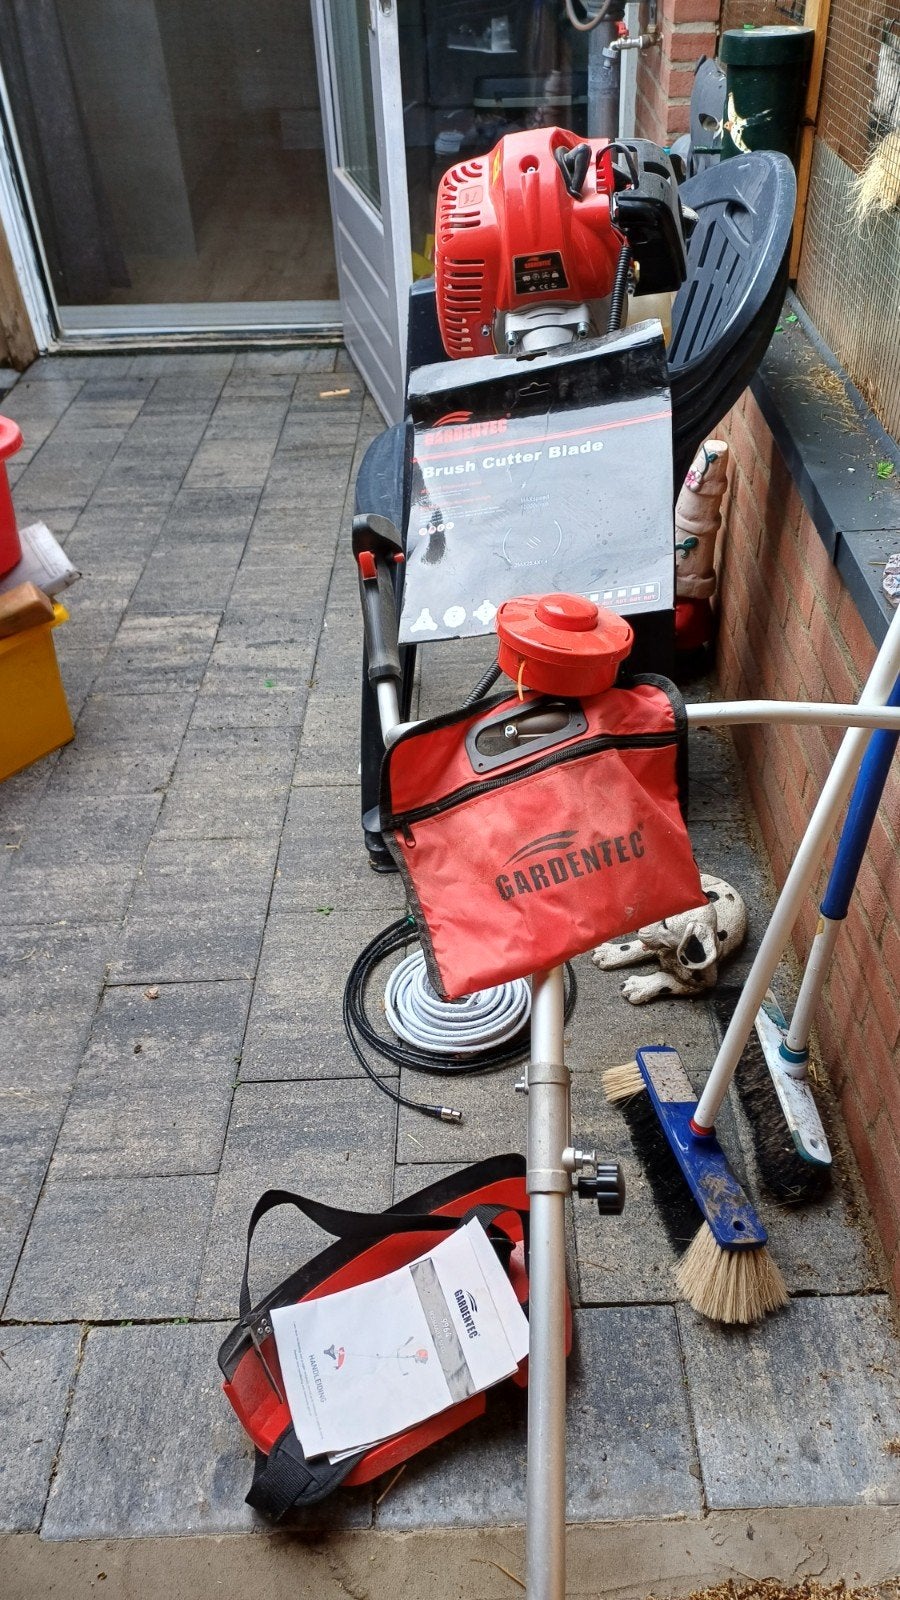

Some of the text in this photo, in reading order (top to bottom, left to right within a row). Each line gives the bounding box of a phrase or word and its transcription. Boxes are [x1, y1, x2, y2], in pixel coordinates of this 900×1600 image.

[422, 440, 604, 479] Brush Cutter Blade
[495, 830, 645, 901] GARDENTEC
[441, 1318, 452, 1338] 9964
[454, 1289, 478, 1339] GARDENTEC
[308, 1354, 327, 1403] HANDLEIDING
